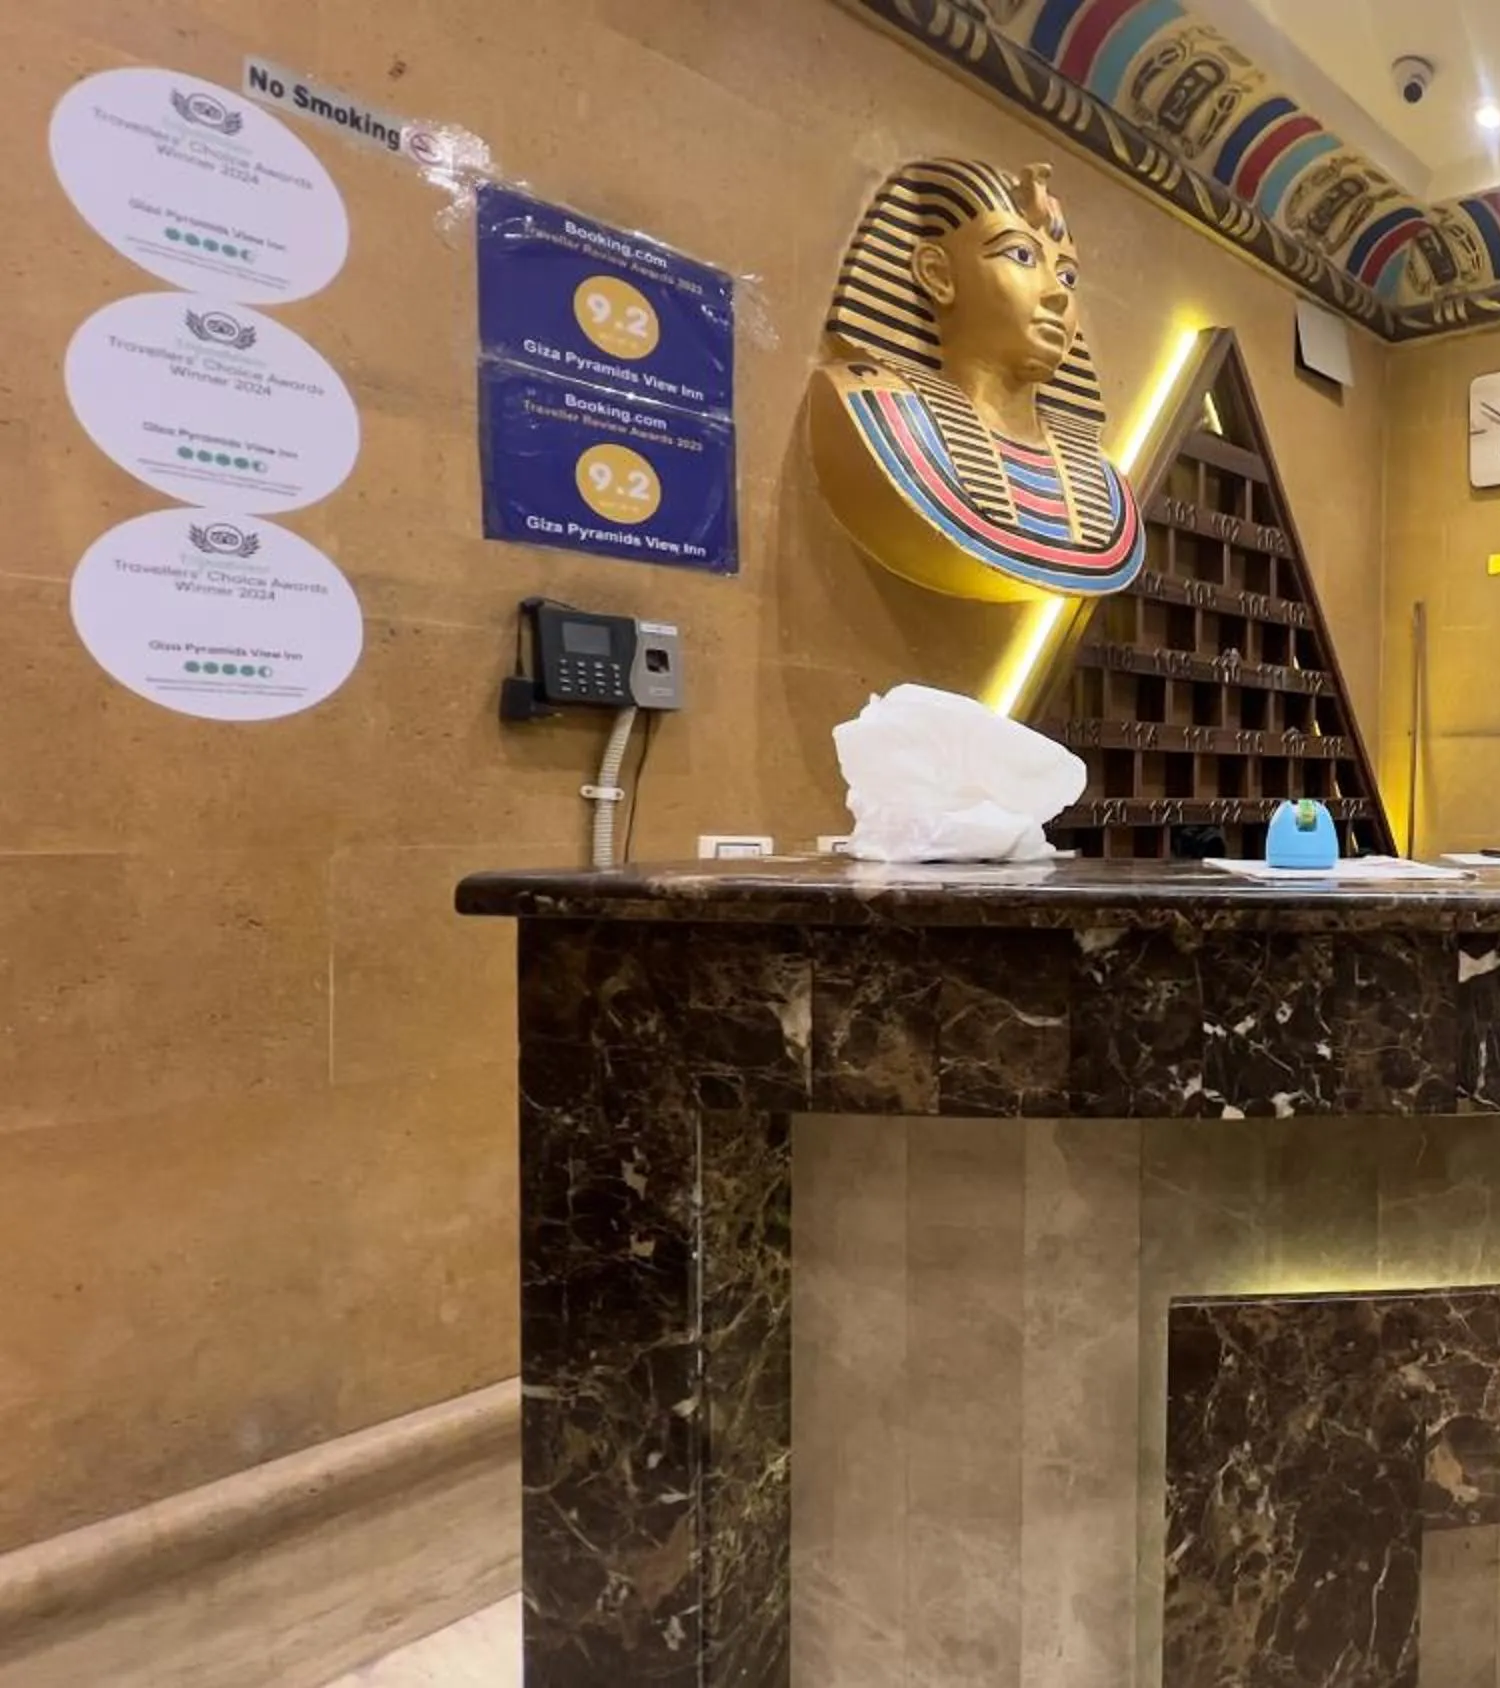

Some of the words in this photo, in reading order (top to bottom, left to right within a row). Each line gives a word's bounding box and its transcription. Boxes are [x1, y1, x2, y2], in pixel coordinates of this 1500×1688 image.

[249, 65, 285, 98] No
[292, 83, 401, 152] Smoking
[565, 221, 668, 269] Booking.com
[582, 241, 627, 268] Review
[630, 260, 675, 285] Awards
[586, 292, 648, 338] 9.2
[170, 365, 228, 387] Winner
[234, 378, 272, 397] 2024
[203, 358, 263, 382] Choice
[267, 373, 325, 397] Awards
[523, 339, 561, 362] Giza
[565, 351, 639, 384] Pyramids
[642, 372, 679, 395] View
[681, 384, 705, 400] Inn
[524, 399, 579, 423] Traveller
[582, 414, 628, 434] Review
[630, 426, 674, 446] Awards
[564, 393, 668, 431] Booking.com
[588, 461, 649, 500] 9.2
[526, 515, 563, 534] Giza
[567, 523, 641, 547] Pyramids
[645, 536, 681, 555] View
[683, 543, 707, 557] Inn
[175, 581, 233, 597] Winner
[238, 586, 276, 602] 2024
[207, 570, 267, 587] Choice
[271, 578, 329, 595] Awards
